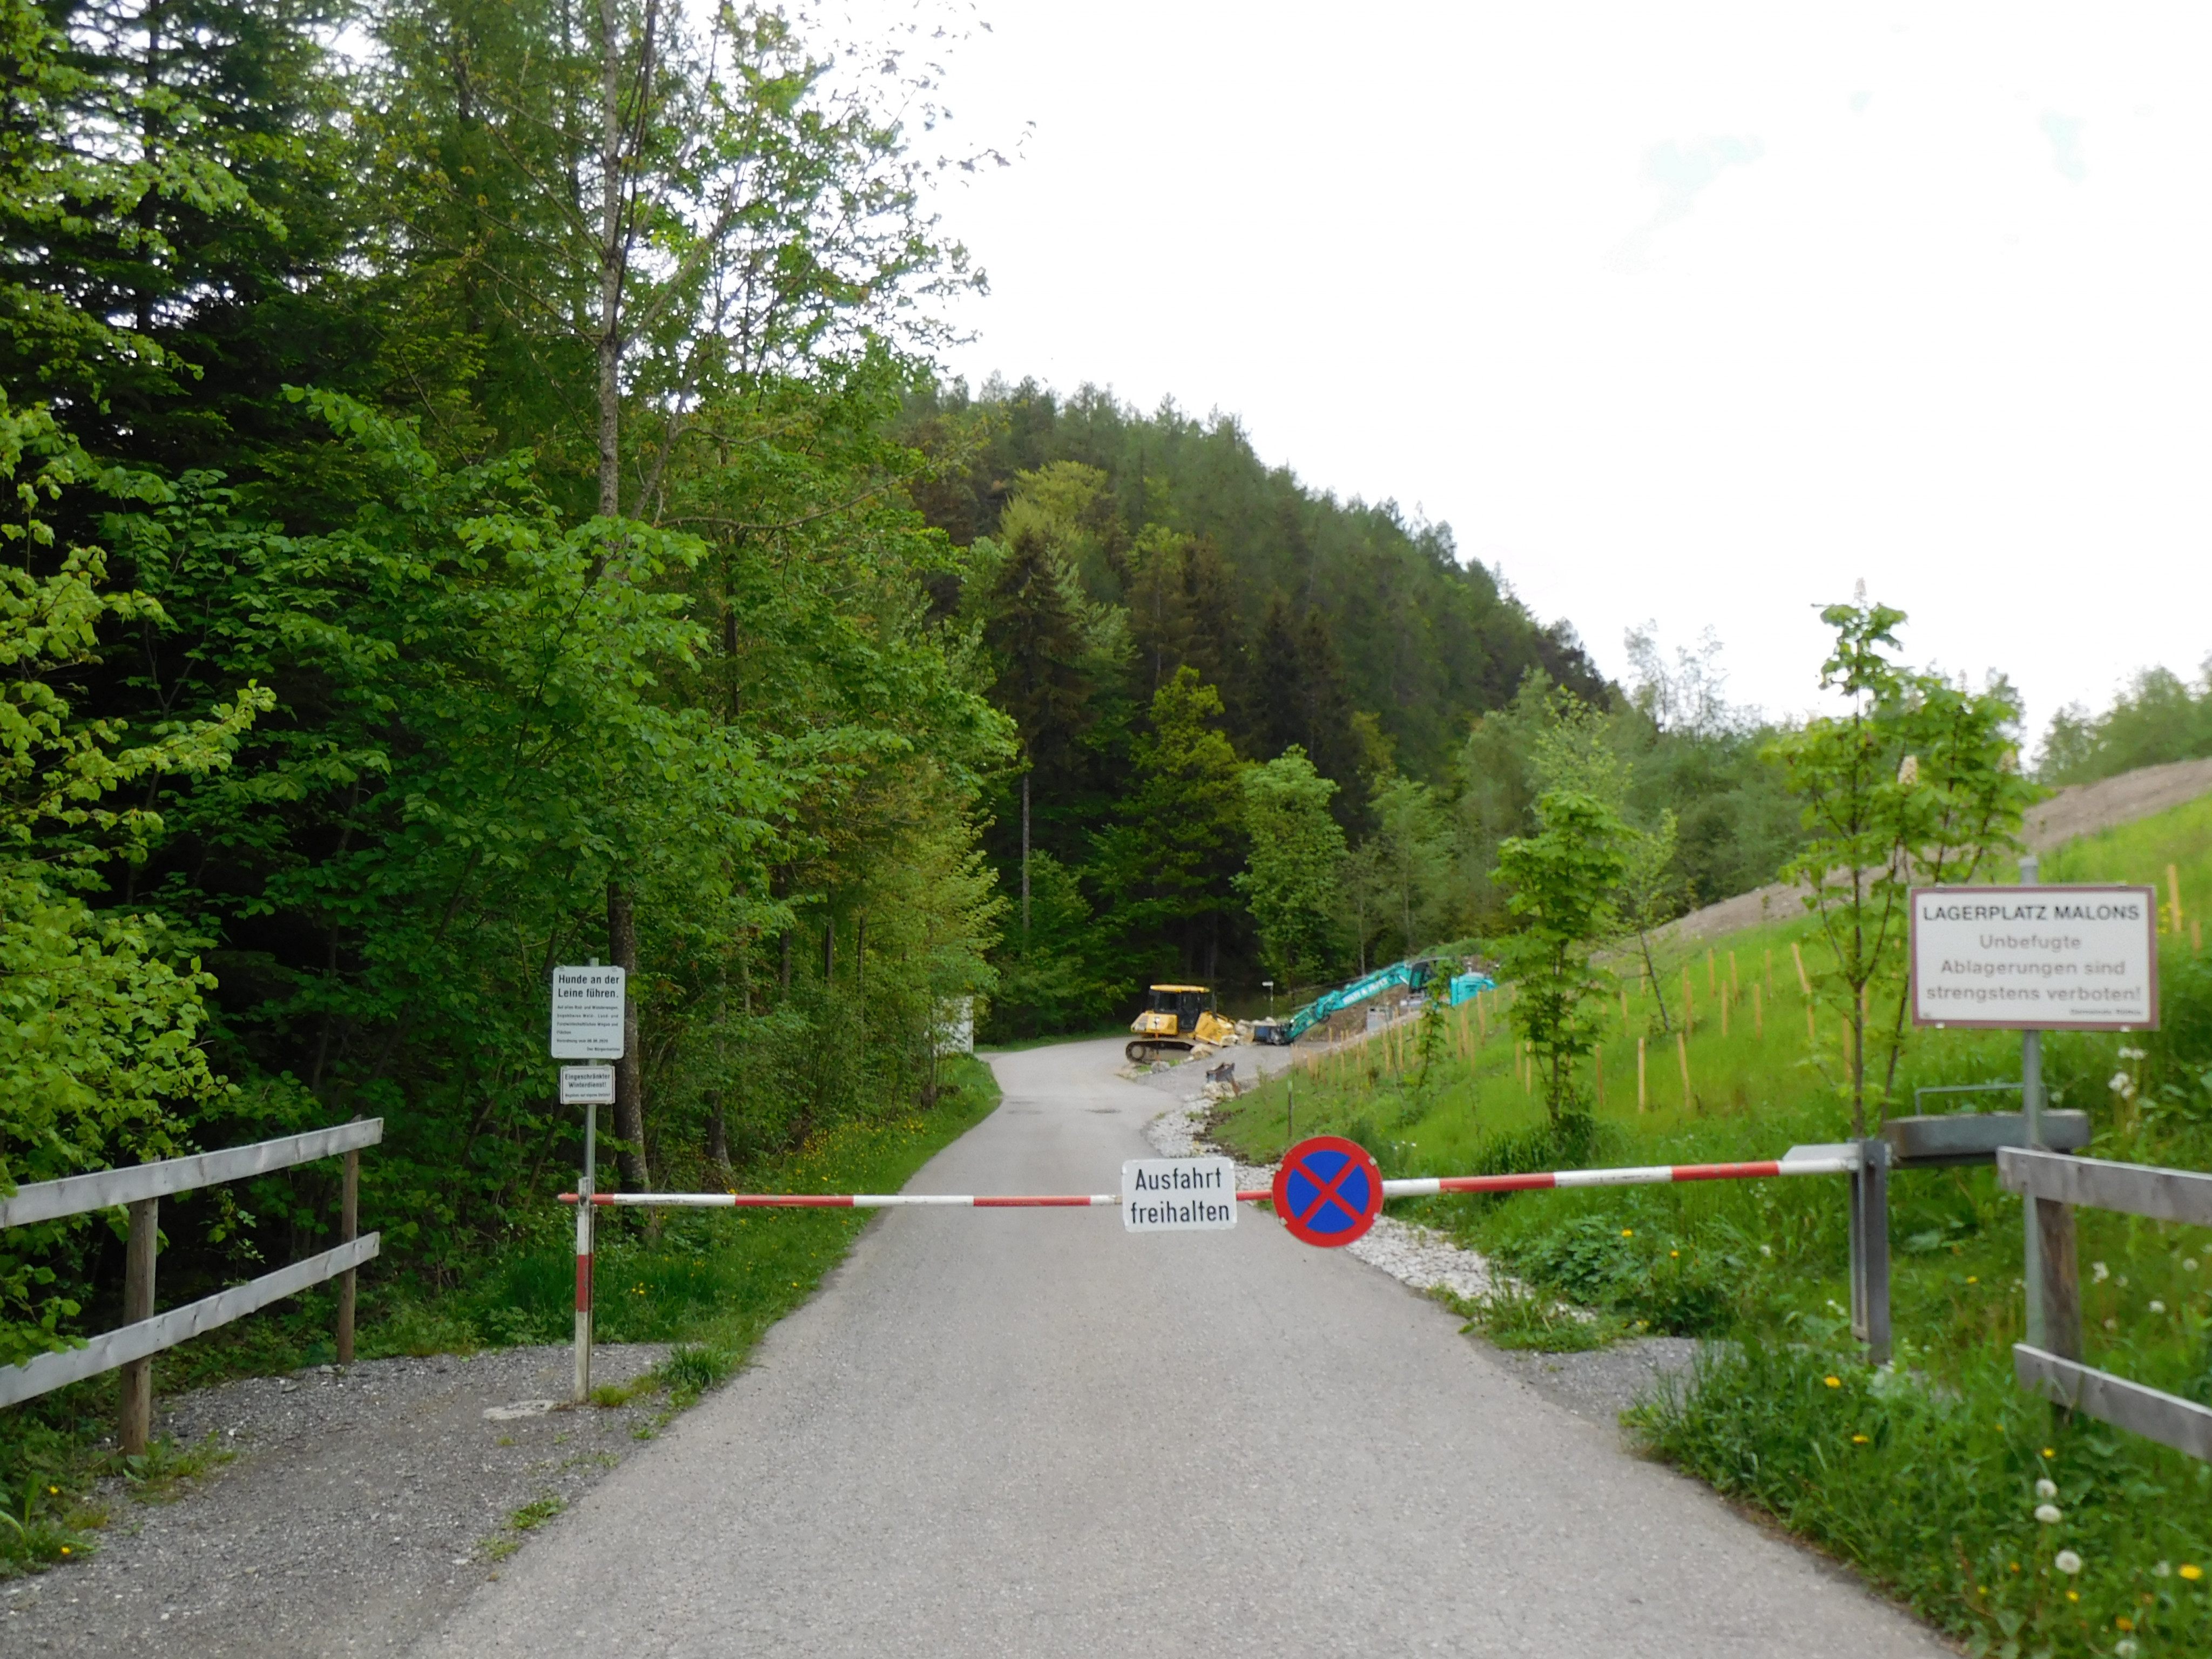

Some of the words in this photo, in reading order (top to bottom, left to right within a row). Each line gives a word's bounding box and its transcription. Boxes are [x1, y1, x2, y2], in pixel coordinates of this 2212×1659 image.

[1924, 906, 2047, 921] LAGERPLATZ
[2054, 905, 2140, 920] MALONS
[1979, 934, 2081, 952] Unbefugte
[1941, 960, 2078, 977] Ablagerungen
[2083, 960, 2126, 975] sind
[559, 974, 587, 984] Hunde
[605, 975, 619, 984] der
[558, 988, 583, 997] Leine
[586, 988, 618, 997] führen.
[1926, 987, 2040, 1003] strengstens
[2047, 986, 2141, 1002] verboten!
[1135, 1167, 1222, 1190] Ausfahrt
[1131, 1200, 1229, 1224] freihalten
